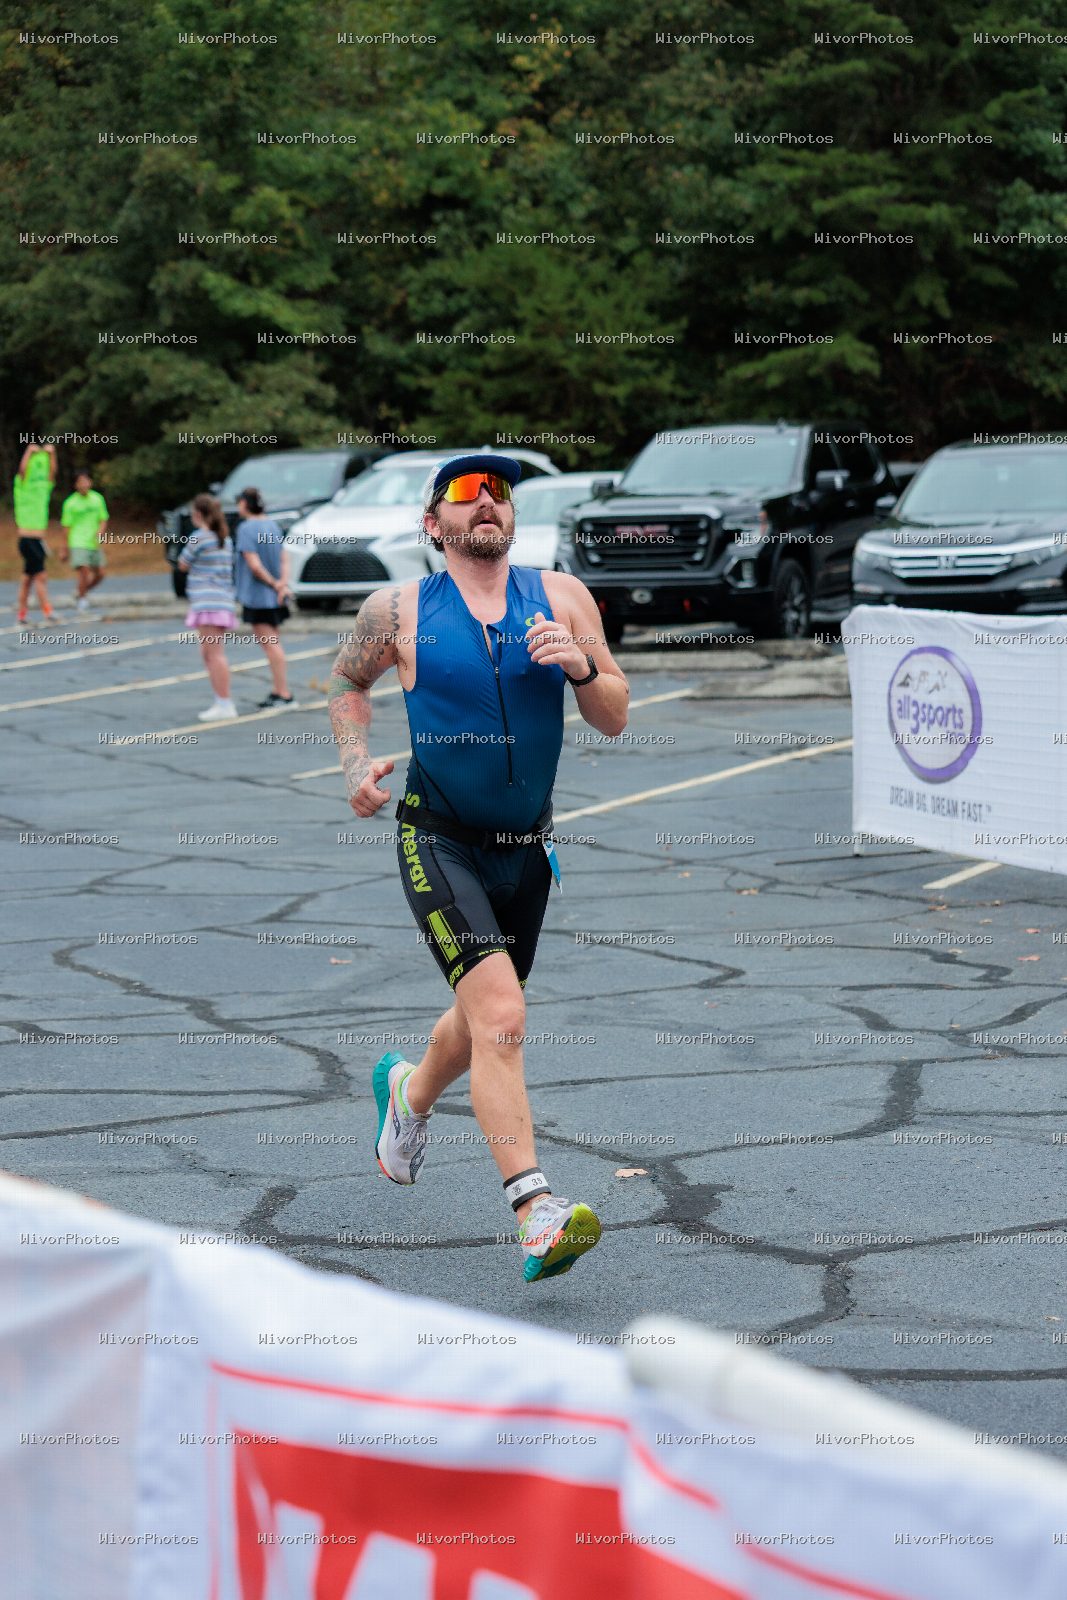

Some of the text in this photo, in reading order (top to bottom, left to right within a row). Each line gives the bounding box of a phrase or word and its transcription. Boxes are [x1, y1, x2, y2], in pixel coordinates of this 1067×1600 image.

[896, 694, 964, 735] all3sports
[889, 785, 914, 809] DREAM
[931, 796, 959, 819] DREAM
